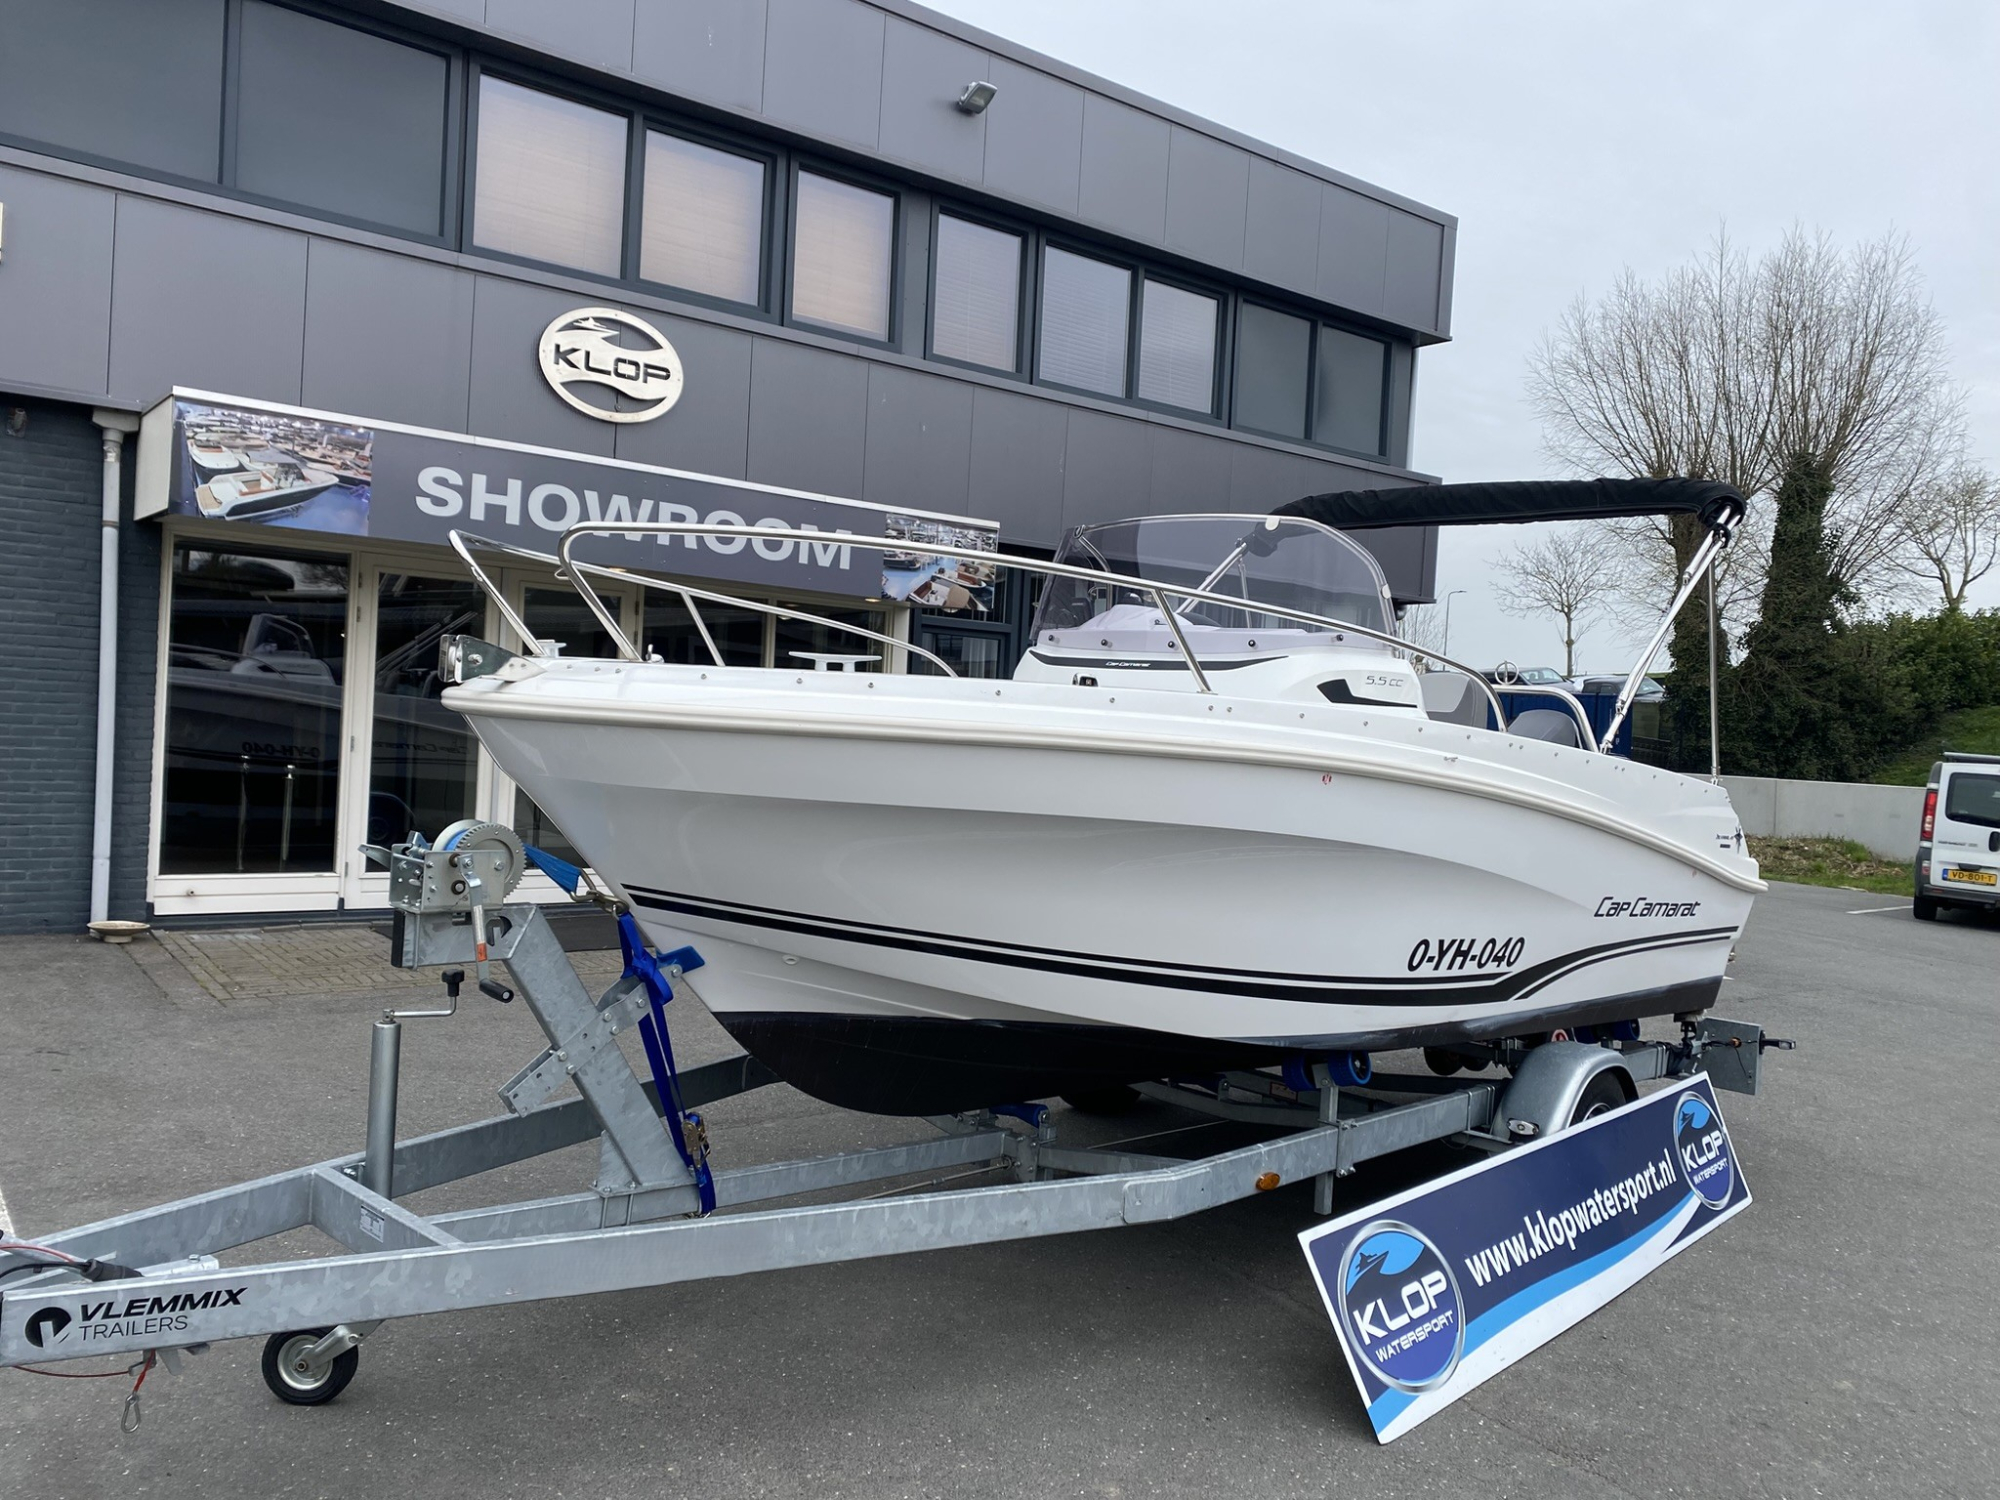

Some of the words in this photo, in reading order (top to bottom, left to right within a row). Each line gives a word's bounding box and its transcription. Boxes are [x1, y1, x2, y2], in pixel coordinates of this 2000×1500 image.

[553, 343, 671, 384] KLOP
[415, 466, 853, 570] SHOWROOM
[1365, 675, 1387, 686] 5.5
[1681, 1130, 1723, 1172] KLOP
[1693, 1158, 1728, 1185] WATERSPORT
[1465, 1148, 1677, 1287] www.klopwatersport.nl
[80, 1287, 248, 1322] VLEMMIX
[1353, 1270, 1447, 1346] KLOP
[79, 1315, 189, 1341] TRAILERS
[1375, 1310, 1454, 1363] WATERSPORT
